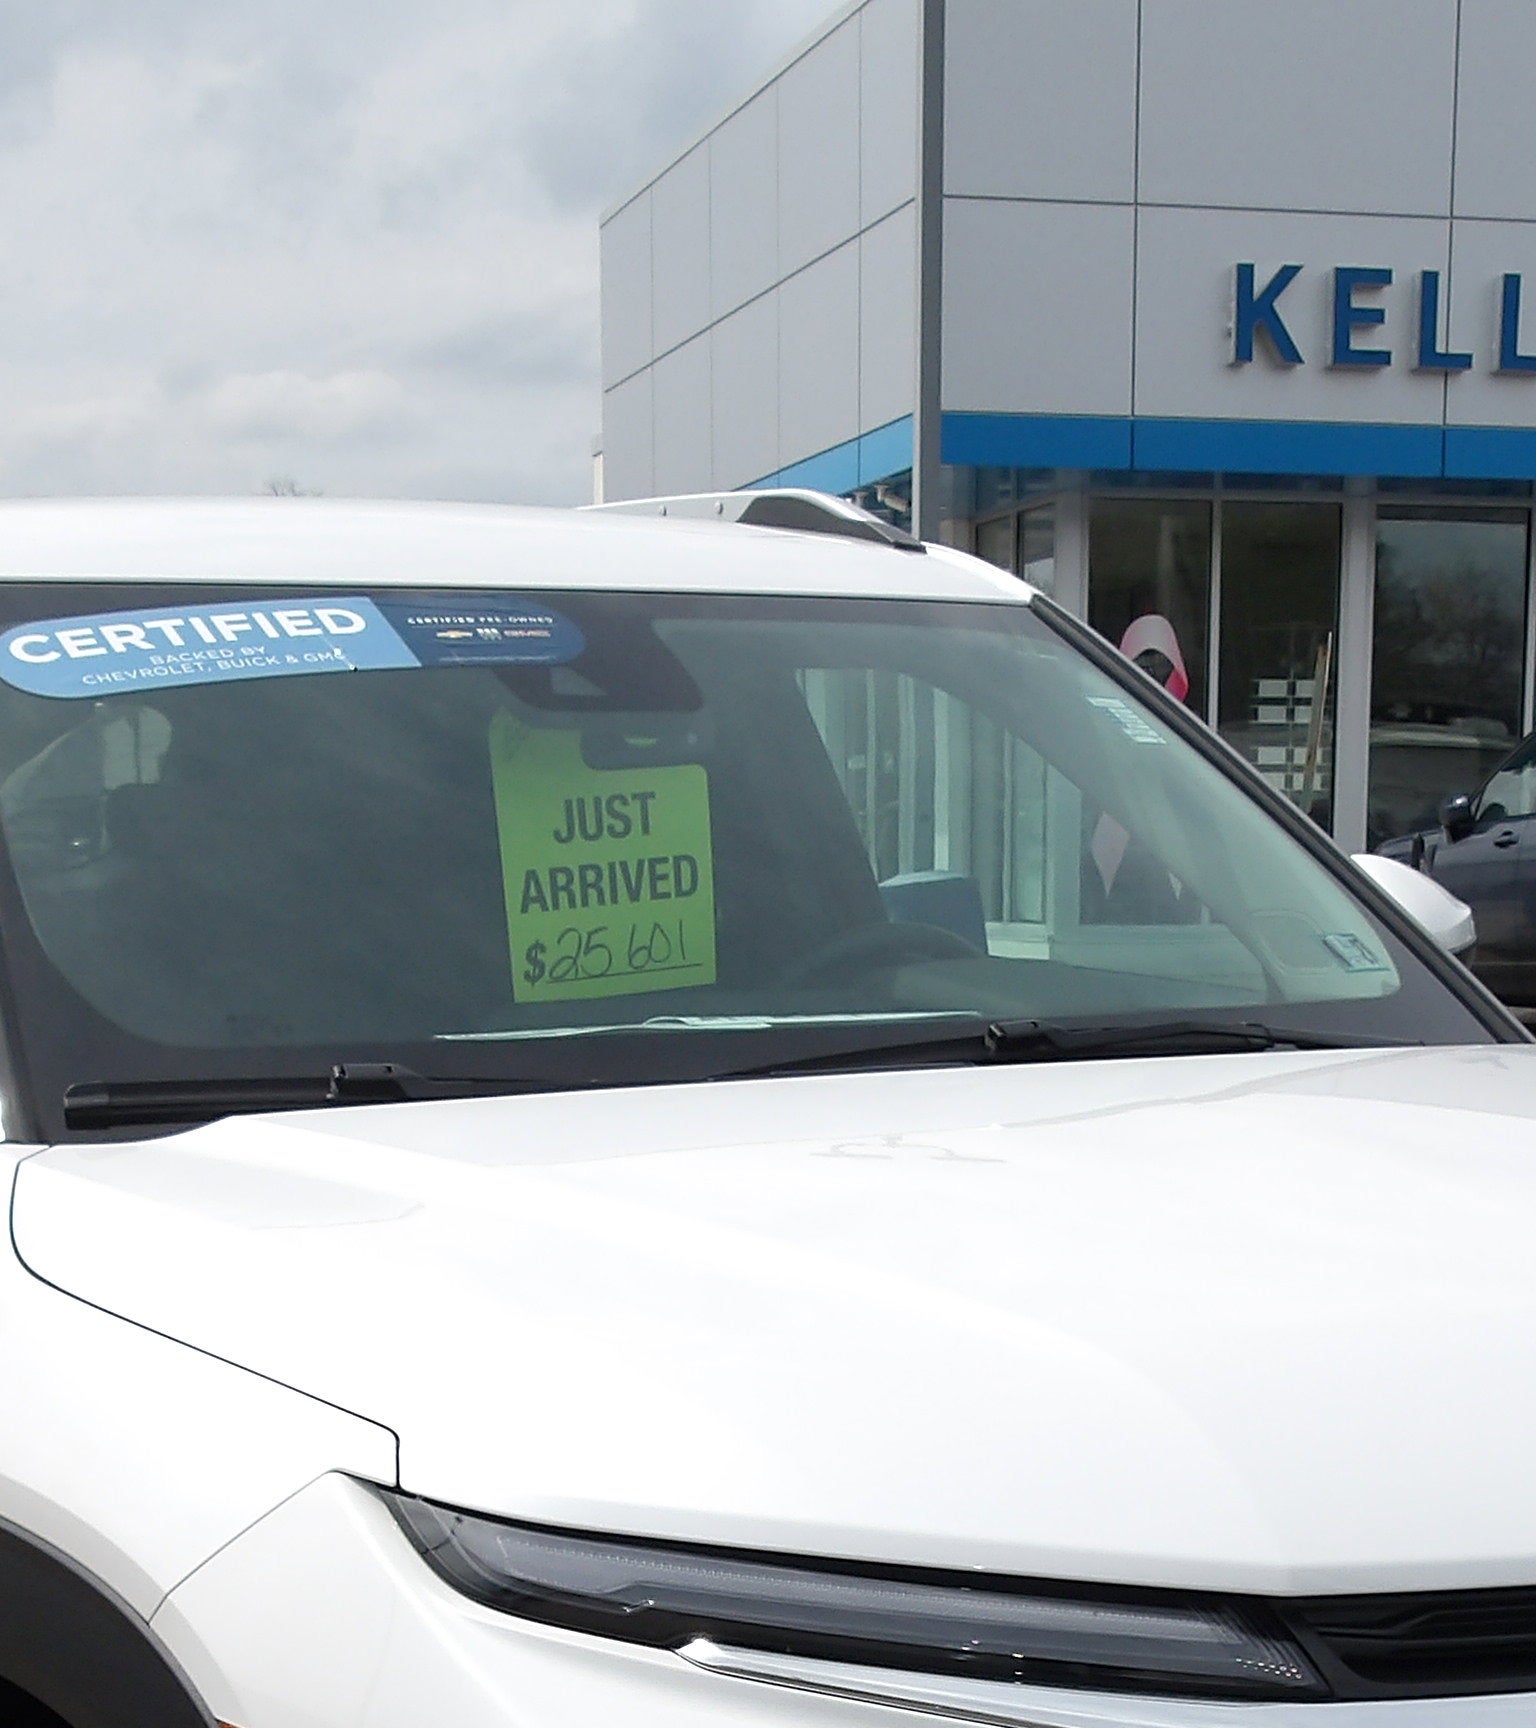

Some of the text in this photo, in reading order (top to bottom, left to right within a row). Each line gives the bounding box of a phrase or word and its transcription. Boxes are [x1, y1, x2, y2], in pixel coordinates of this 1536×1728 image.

[8, 607, 367, 664] CERTIFIED
[148, 645, 267, 667] BACKED BY
[215, 655, 281, 671] BUICK
[285, 654, 299, 664] &
[552, 790, 657, 845] JUST
[520, 853, 700, 915] ARRIVED
